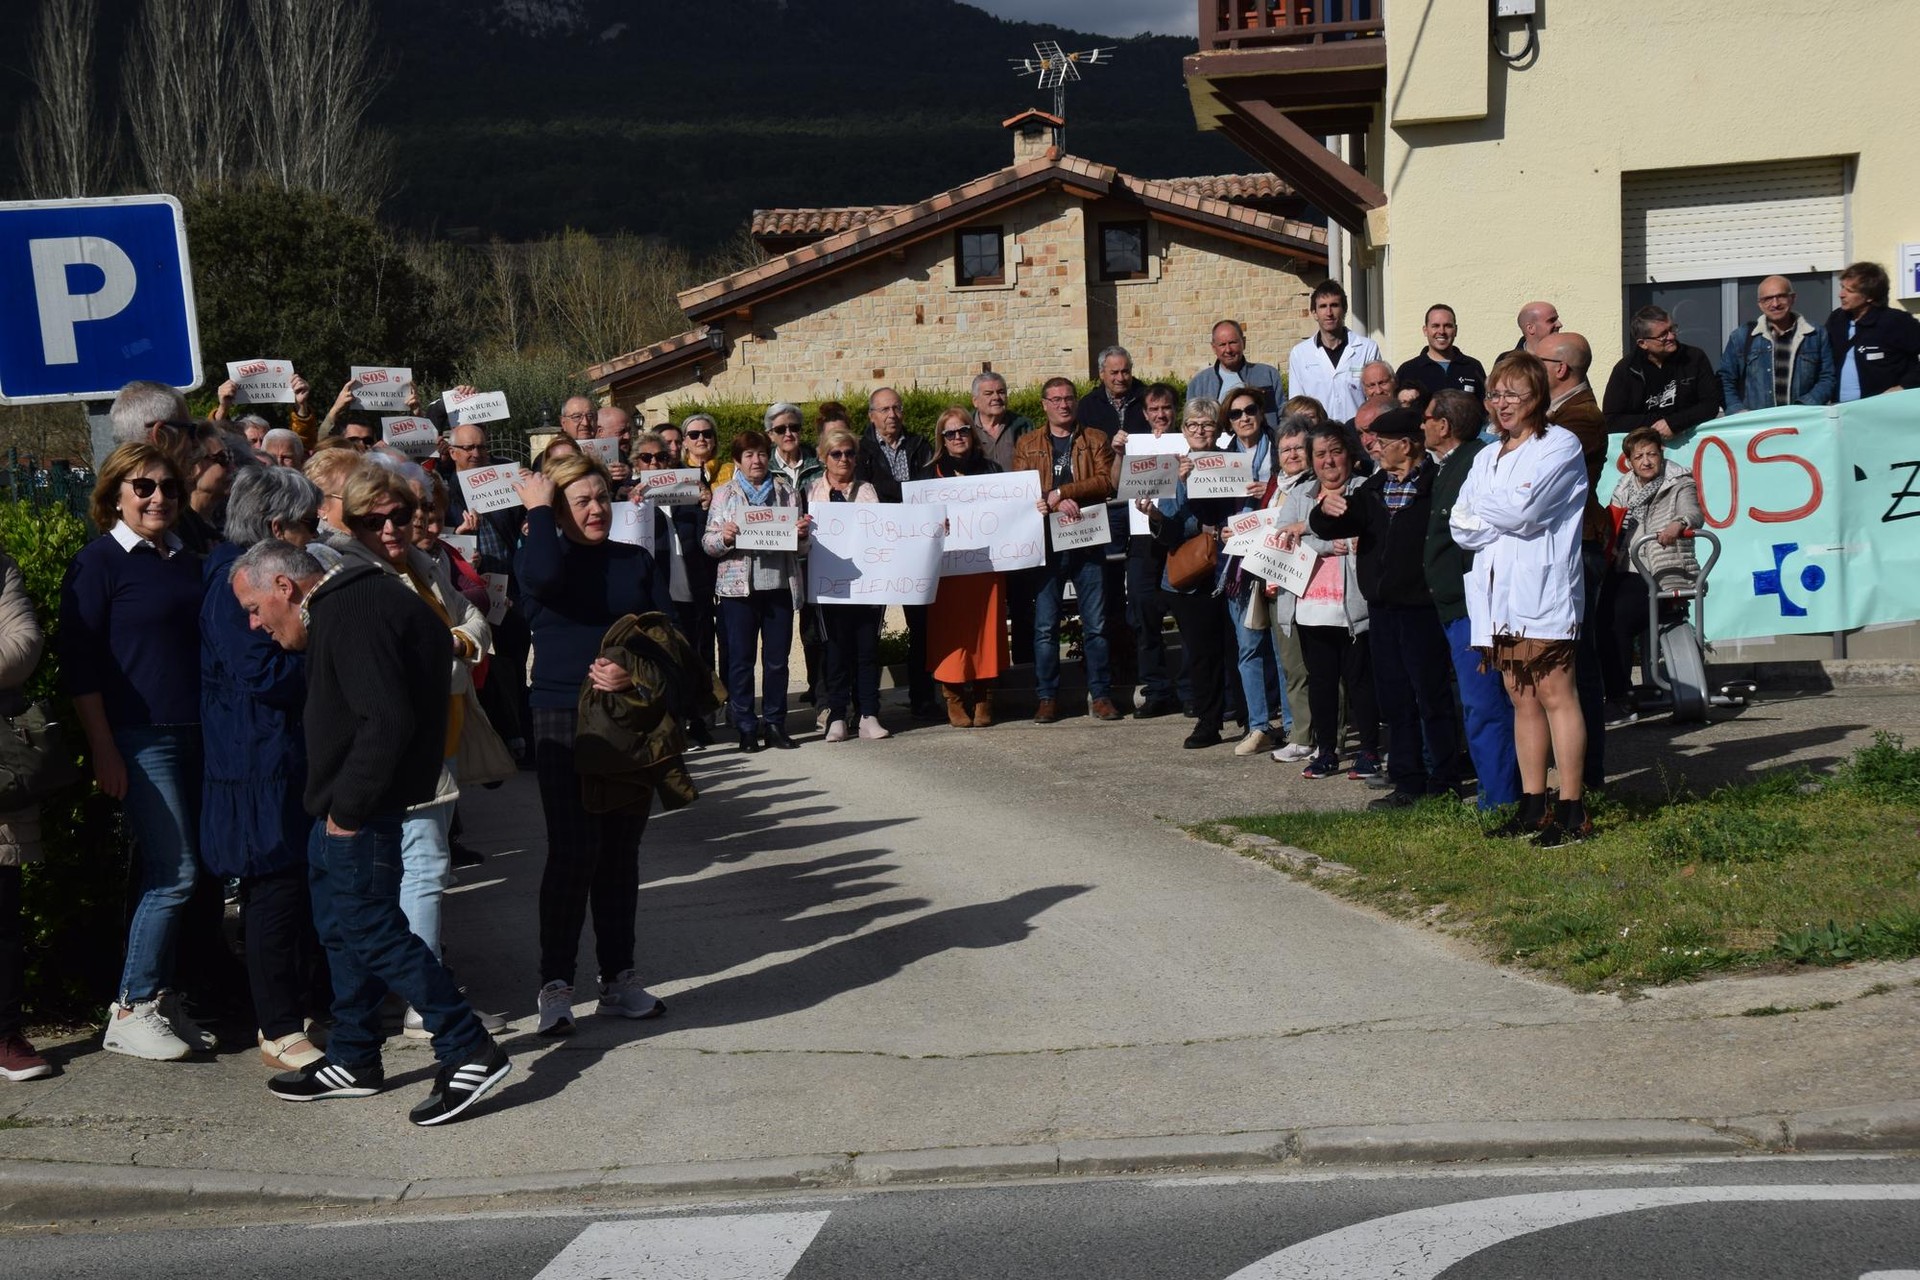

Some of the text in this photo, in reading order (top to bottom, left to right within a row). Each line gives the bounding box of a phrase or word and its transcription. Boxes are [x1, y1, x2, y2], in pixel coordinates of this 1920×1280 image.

[29, 236, 137, 365] P
[240, 363, 266, 376] SOS
[362, 371, 386, 384] SOS
[475, 400, 501, 409] RURAL
[467, 411, 492, 420] ARABA
[393, 420, 415, 434] SOS
[1133, 460, 1156, 472] SOS
[1198, 457, 1224, 469] SOS
[471, 470, 496, 486] SOS
[650, 473, 676, 487] SOS
[1148, 478, 1172, 486] RURAL
[1194, 476, 1217, 484] ZONA
[1616, 427, 1823, 529] OS
[471, 486, 517, 501] ZONA RURA
[1137, 488, 1160, 496] ARABA
[1207, 486, 1234, 494] ARABA
[485, 497, 511, 508] ARABA
[747, 511, 772, 523] SOS
[815, 509, 944, 542] LO PUBLICO
[957, 510, 999, 540] NO
[1236, 515, 1258, 533] SOS
[1058, 526, 1103, 538] ZONA RURAL
[1070, 536, 1093, 545] ARABA
[863, 546, 896, 564] SE
[1253, 550, 1304, 580] ZONA RURAL
[1261, 567, 1288, 583] ARABA
